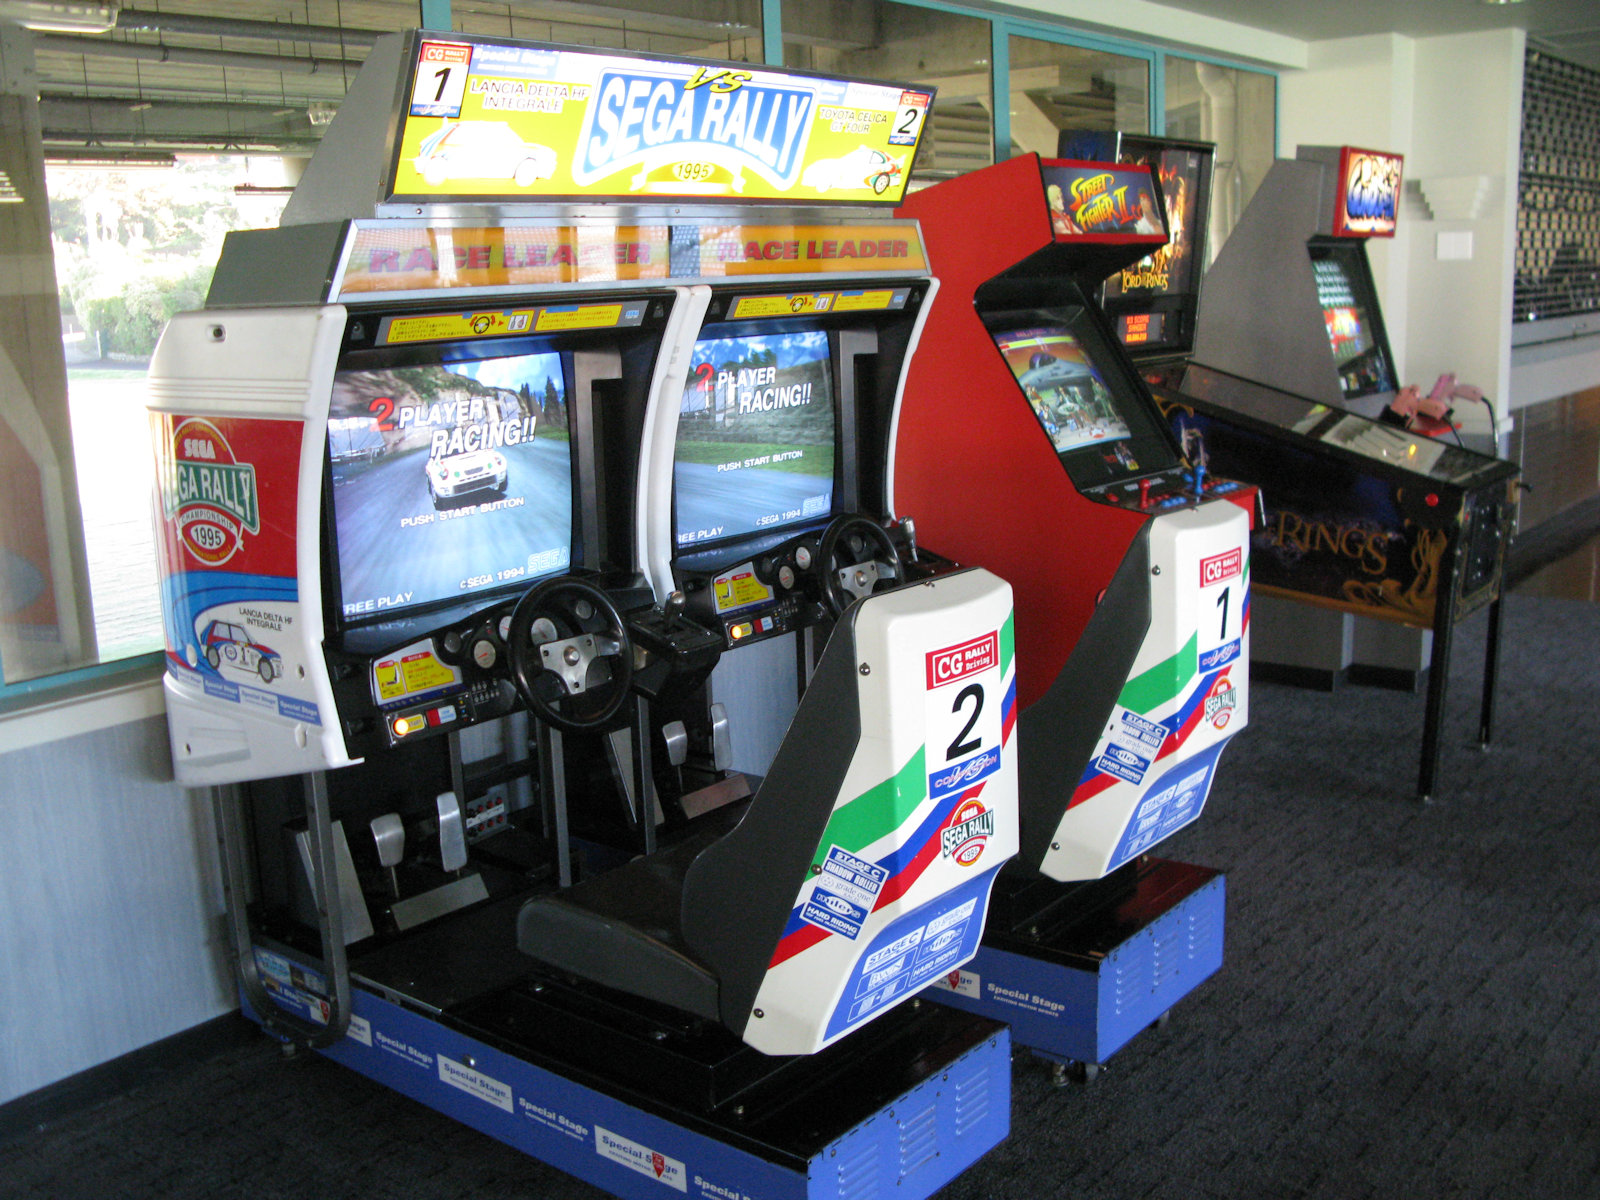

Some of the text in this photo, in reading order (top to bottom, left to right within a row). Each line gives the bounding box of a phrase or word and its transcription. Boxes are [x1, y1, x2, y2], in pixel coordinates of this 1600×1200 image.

[428, 48, 443, 60] CG
[434, 67, 452, 101] 1
[471, 79, 588, 97] LANCIA DELTA HF
[684, 67, 752, 93] VS
[484, 96, 563, 111] INTEGRALE
[821, 108, 887, 123] TOYOTA CELICA
[588, 76, 811, 174] SEGA RALLY
[897, 108, 918, 134] 2
[677, 162, 709, 179] 1995
[1069, 173, 1115, 211] STREET
[1076, 193, 1121, 231] FIGHTER
[369, 242, 651, 273] RACE LEADER
[718, 239, 909, 262] RACE LEADER
[1121, 269, 1142, 294] LORD
[1146, 271, 1169, 292] RINGS
[695, 363, 776, 392] 2 PLAYER
[739, 382, 812, 414] RACING!!
[368, 396, 483, 432] 2 PLAYER
[430, 416, 537, 458] RACING!!
[717, 450, 803, 472] PUSH START BUTTON
[201, 468, 251, 522] RALLY
[181, 510, 234, 530] CHAMPIONSHIP
[401, 497, 525, 528] PUSH START BUTTON
[782, 508, 801, 520] 1994
[194, 527, 222, 546] 1995
[698, 526, 723, 540] PLAY
[1277, 510, 1392, 575] RINGS
[527, 546, 571, 575] SEGA
[1207, 560, 1222, 581] CG
[497, 567, 525, 581] 1994
[239, 607, 263, 619] LANCIA
[263, 612, 283, 623] DELTA
[344, 591, 414, 615] REE PLAY
[1216, 586, 1230, 641] 1
[246, 618, 283, 632] INTEGRALE
[965, 643, 991, 660] RALLY
[966, 655, 991, 671] Driving
[938, 653, 964, 679] CG
[946, 683, 985, 762] 2
[1101, 758, 1120, 772] HARD
[943, 823, 968, 856] SEGA
[968, 810, 993, 837] RALLY
[834, 851, 882, 879] STAGE C
[963, 847, 979, 861] 1995
[825, 861, 880, 894] SHADOW ROLLER
[835, 881, 872, 901] grade one
[806, 906, 831, 921] HARD
[831, 916, 858, 933] RIDING
[869, 931, 920, 963] STAGE C
[913, 960, 934, 977] HARD
[987, 983, 1066, 1012] Special Stage
[375, 1031, 407, 1052] Special
[408, 1046, 433, 1064] Stage
[444, 1063, 478, 1084] Special
[479, 1078, 507, 1097] Stage
[518, 1097, 556, 1121] Special
[558, 1112, 589, 1137] Stage
[602, 1135, 644, 1161] Special
[645, 1153, 678, 1176] Sge
[694, 1175, 741, 1200] Special
